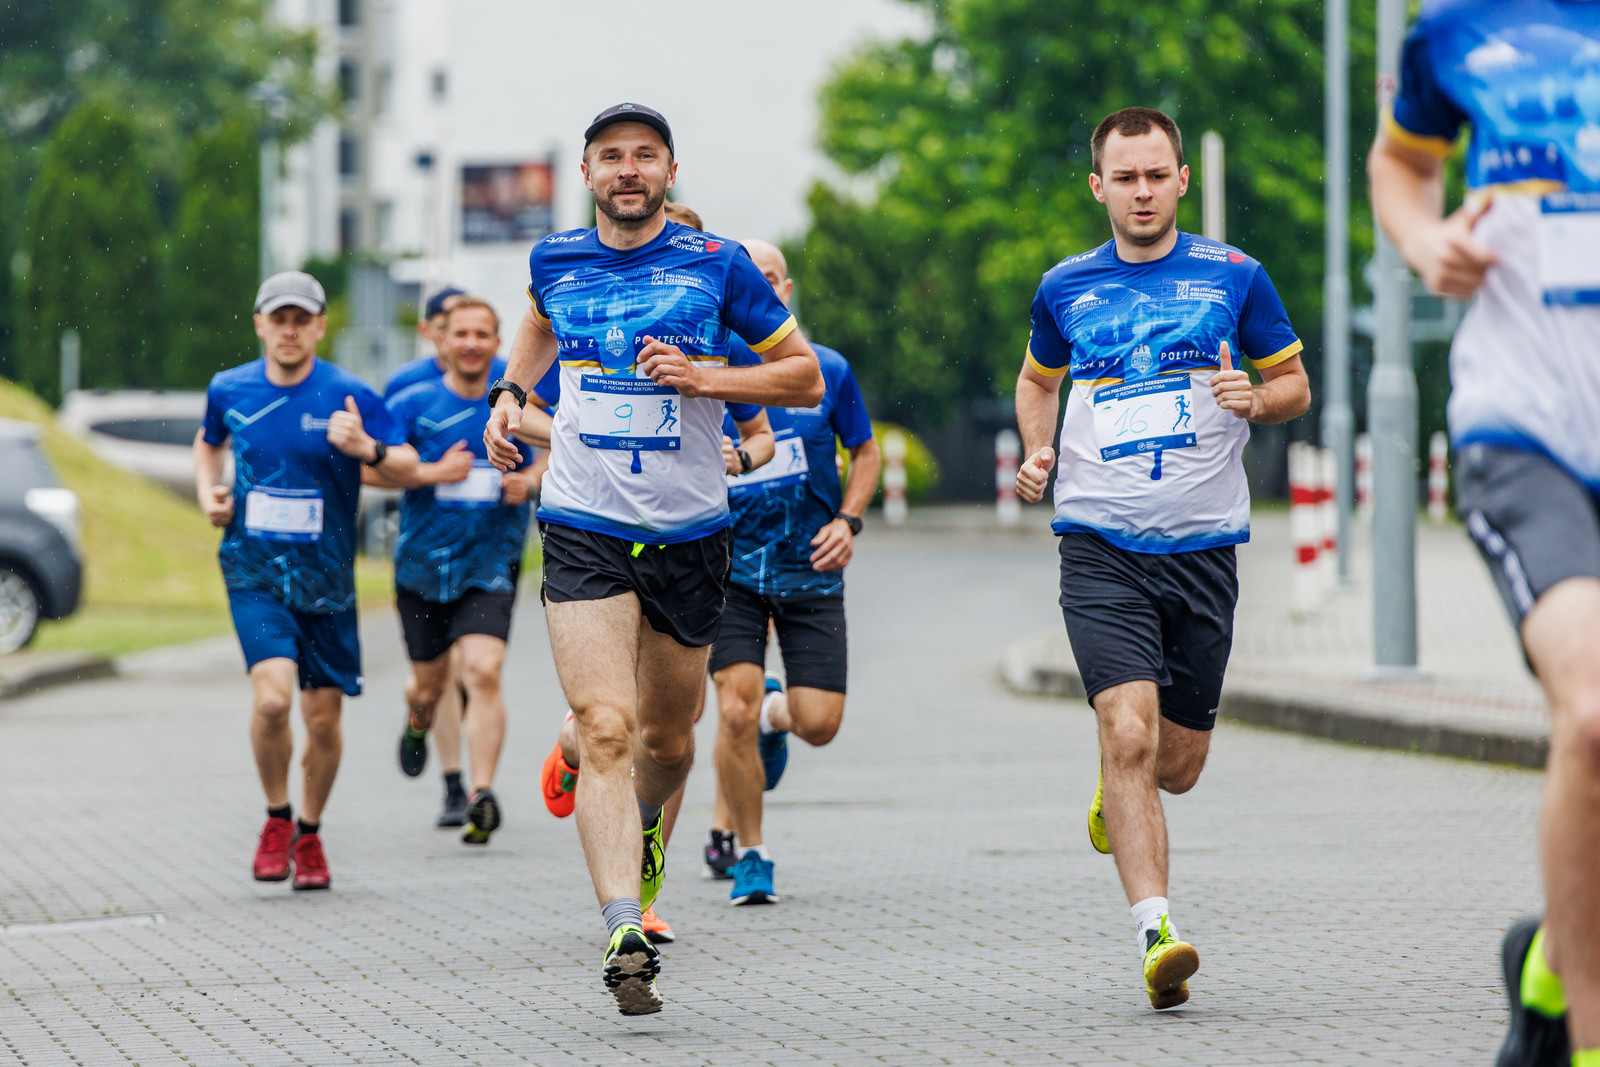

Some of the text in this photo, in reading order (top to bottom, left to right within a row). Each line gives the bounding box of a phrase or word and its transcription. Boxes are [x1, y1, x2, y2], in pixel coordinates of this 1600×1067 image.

[1190, 246, 1227, 255] CENTRUM
[1188, 251, 1228, 262] MEDYCZNE
[588, 338, 594, 348] Z
[1111, 382, 1144, 394] POLITECHNIKI
[609, 403, 633, 434] 9
[1114, 404, 1153, 437] 16
